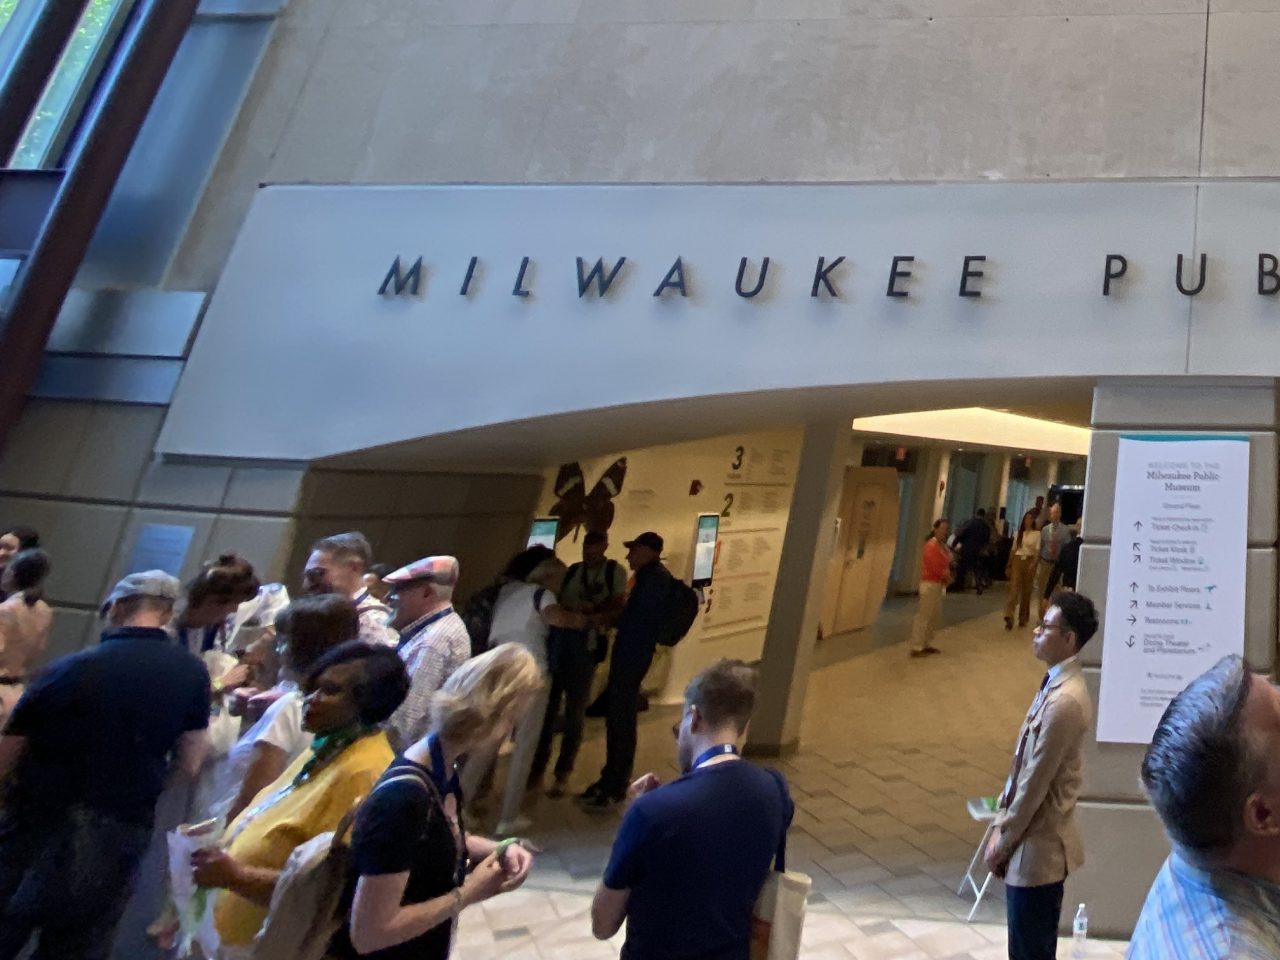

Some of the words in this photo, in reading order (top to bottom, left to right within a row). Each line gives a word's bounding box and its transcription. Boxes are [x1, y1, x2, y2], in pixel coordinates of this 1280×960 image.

[377, 254, 988, 299] MILWAUKEE
[732, 446, 744, 470] 3
[1146, 471, 1192, 480] Milwaukee
[1193, 471, 1220, 480] Public
[1164, 482, 1201, 492] Museum
[721, 493, 734, 517] 2
